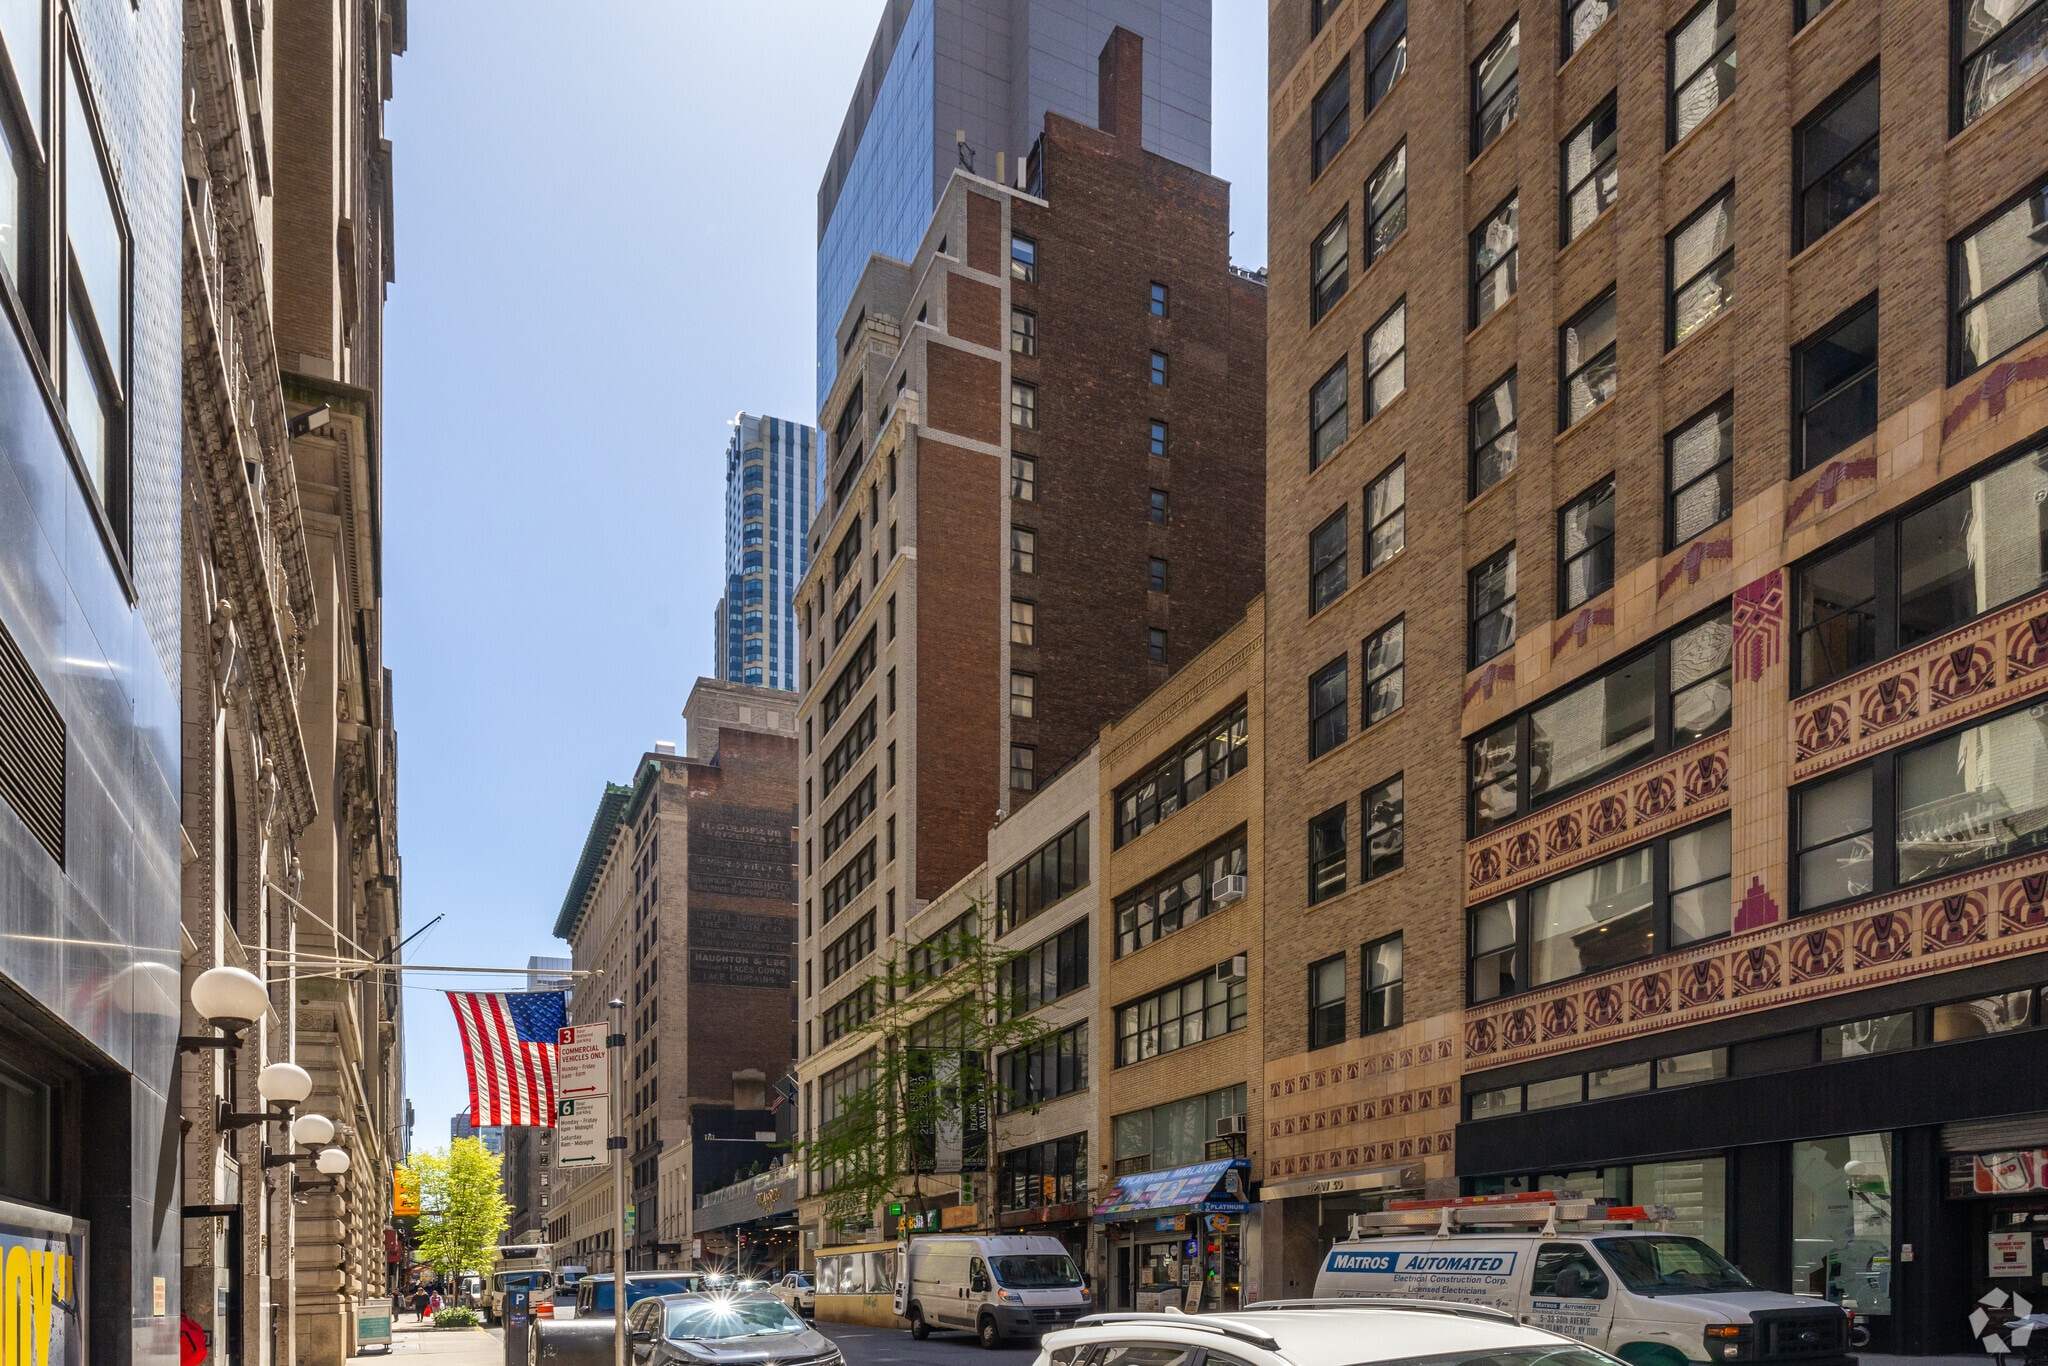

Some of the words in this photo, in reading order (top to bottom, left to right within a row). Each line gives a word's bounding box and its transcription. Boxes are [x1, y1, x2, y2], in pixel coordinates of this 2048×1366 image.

[699, 920, 721, 928] THE
[695, 952, 749, 964] HAUGHTON
[753, 957, 762, 965] &
[766, 957, 787, 967] LEE
[757, 966, 786, 976] GOWNS
[563, 1030, 571, 1044] 3
[562, 1045, 599, 1056] COMMERCIAL
[562, 1053, 589, 1063] VEHICLES
[590, 1051, 606, 1060] ONLY
[562, 1101, 571, 1115] 6
[969, 1103, 978, 1131] FLOOR
[574, 1139, 594, 1147] Midnight
[1124, 1171, 1171, 1186] PLATINUM
[1172, 1161, 1227, 1178] MIDLANTIC
[1321, 1181, 1331, 1192] W
[1332, 1180, 1344, 1190] 39
[1333, 1254, 1389, 1271] MATROS
[1404, 1254, 1504, 1272] AUTOMATED
[1393, 1274, 1428, 1283] Electrical
[1430, 1274, 1482, 1285] Construction
[1485, 1275, 1508, 1287] Corp.
[1408, 1285, 1441, 1294] Licensed
[1442, 1286, 1487, 1296] Electricians
[516, 1293, 525, 1305] P
[1569, 1317, 1591, 1326] AVENUE
[1564, 1326, 1577, 1335] CITY,
[1578, 1327, 1586, 1335] NY
